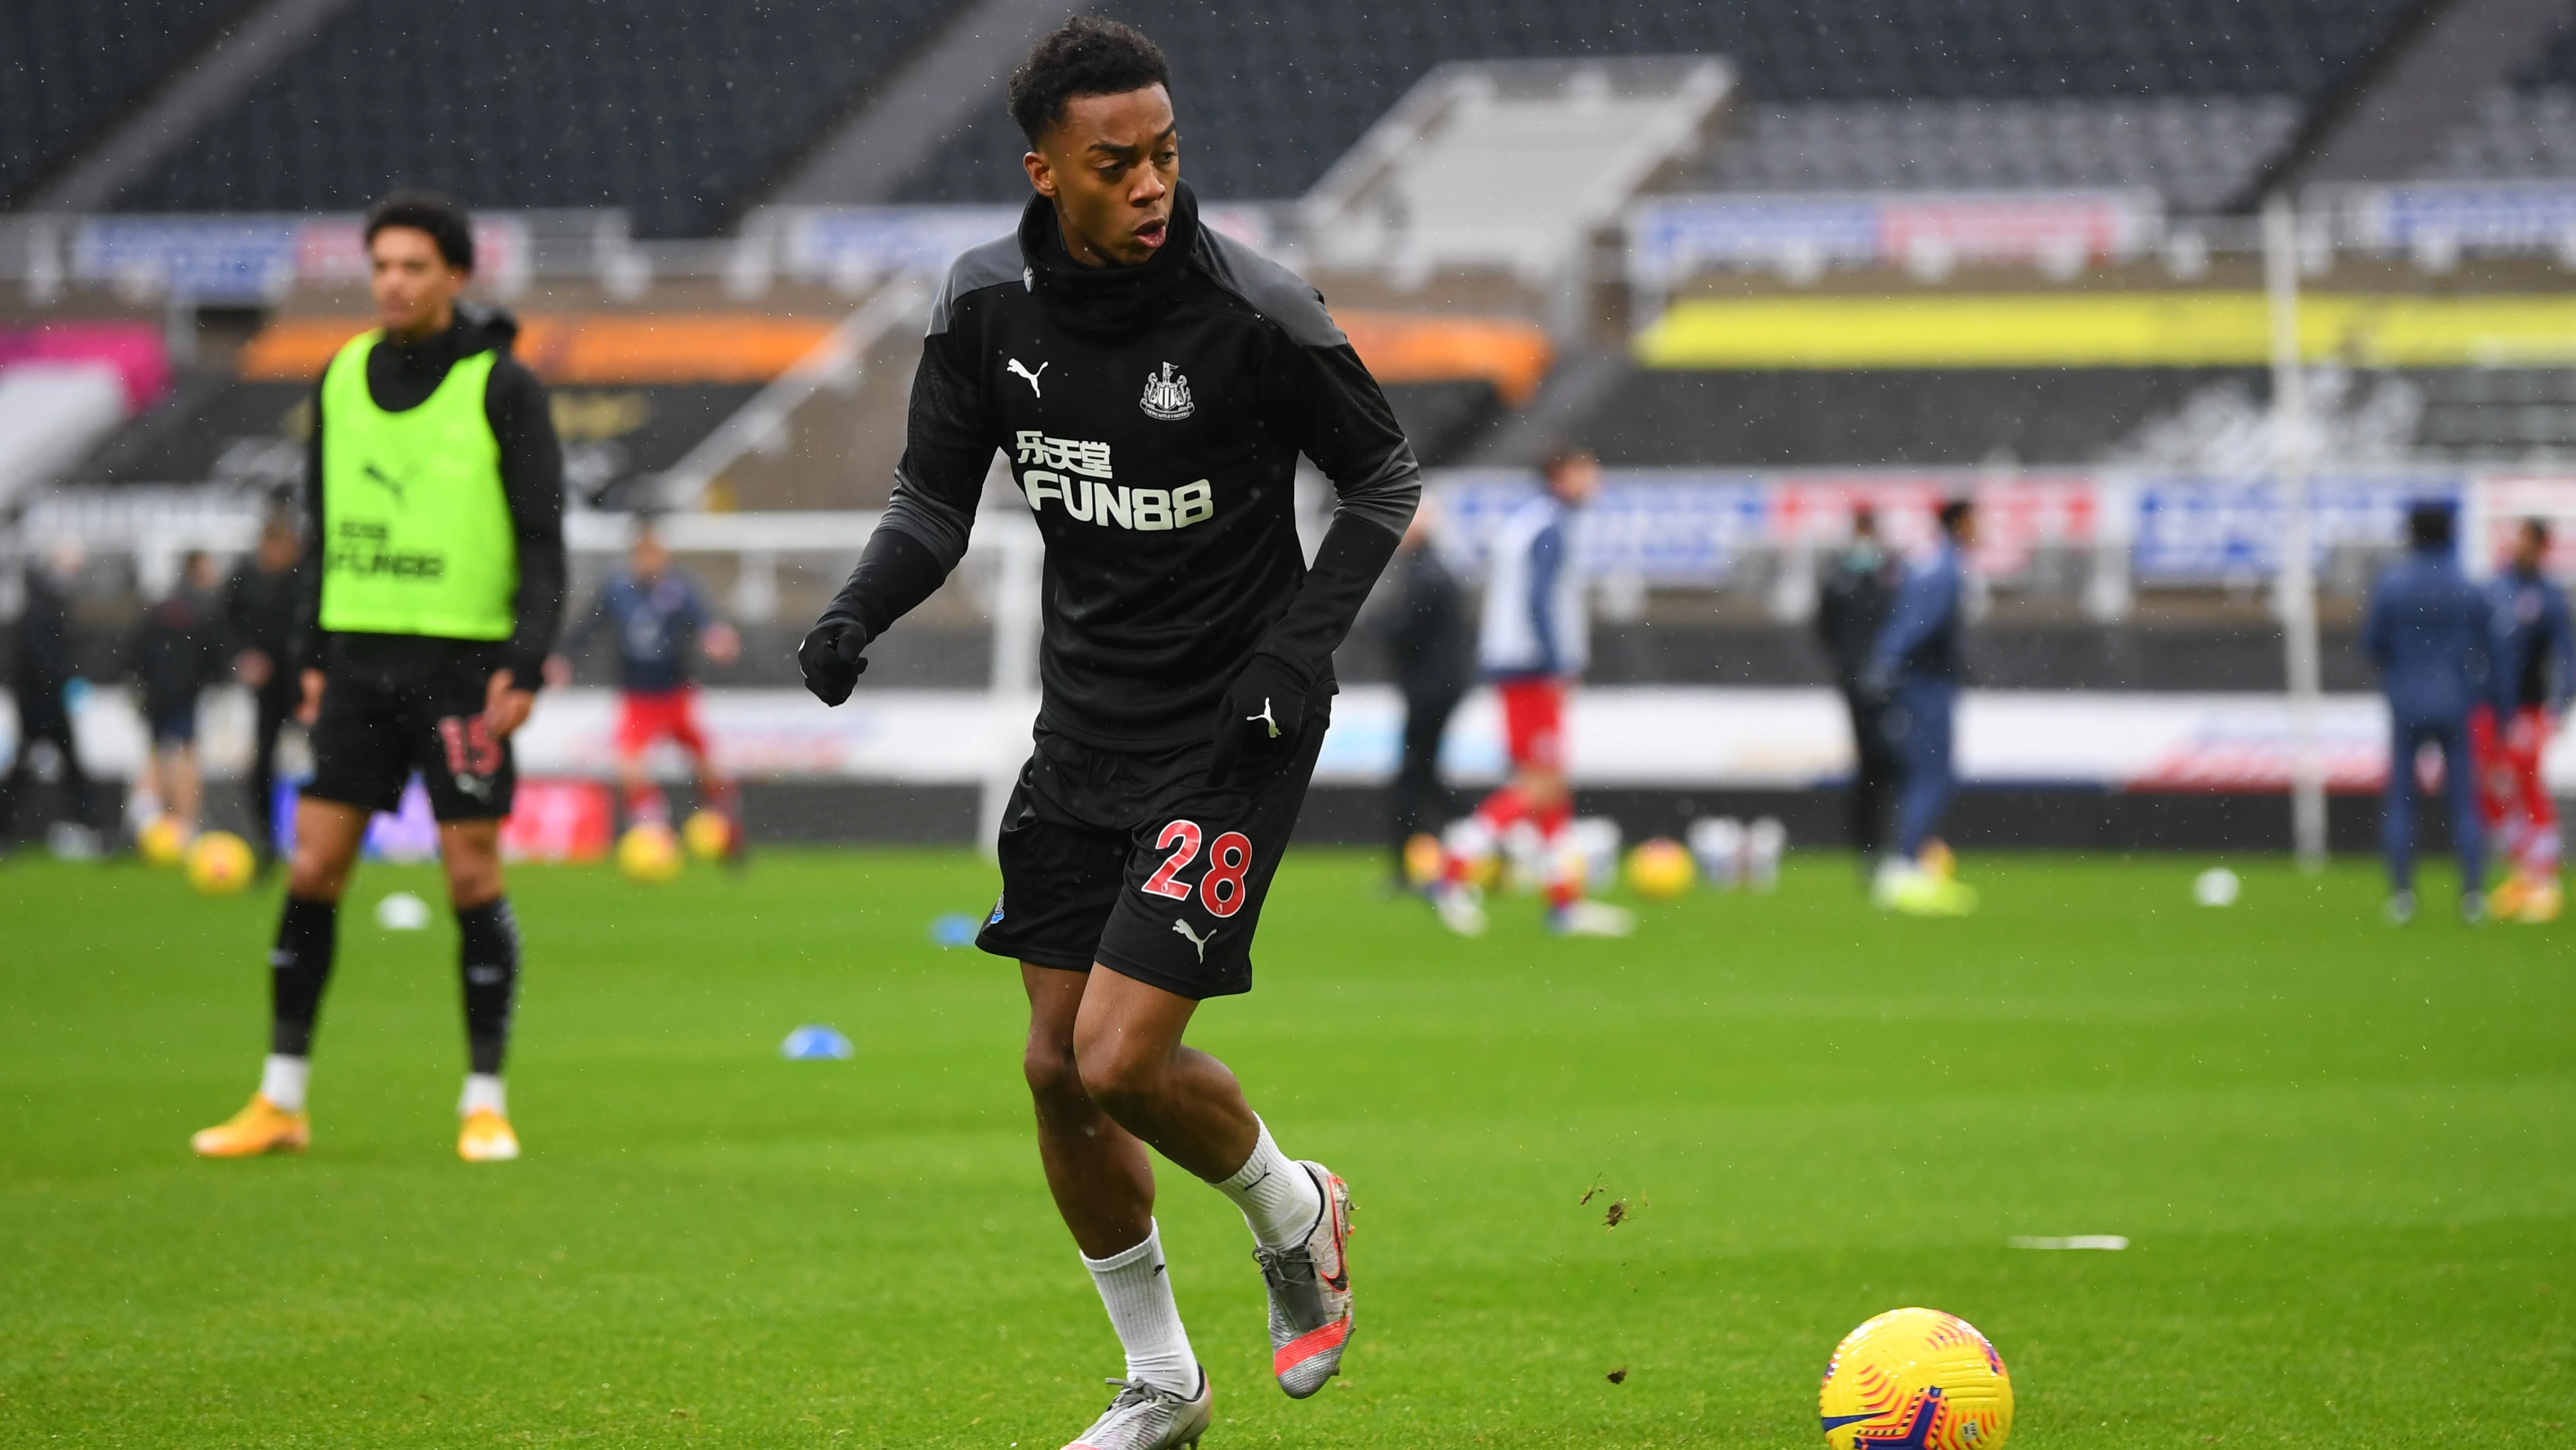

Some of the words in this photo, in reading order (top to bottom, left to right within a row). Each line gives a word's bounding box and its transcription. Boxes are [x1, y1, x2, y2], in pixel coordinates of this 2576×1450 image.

[1016, 431, 1113, 479] 乐天堂
[1023, 470, 1213, 531] FUN88
[437, 715, 505, 777] 15
[1141, 819, 1252, 918] 28
